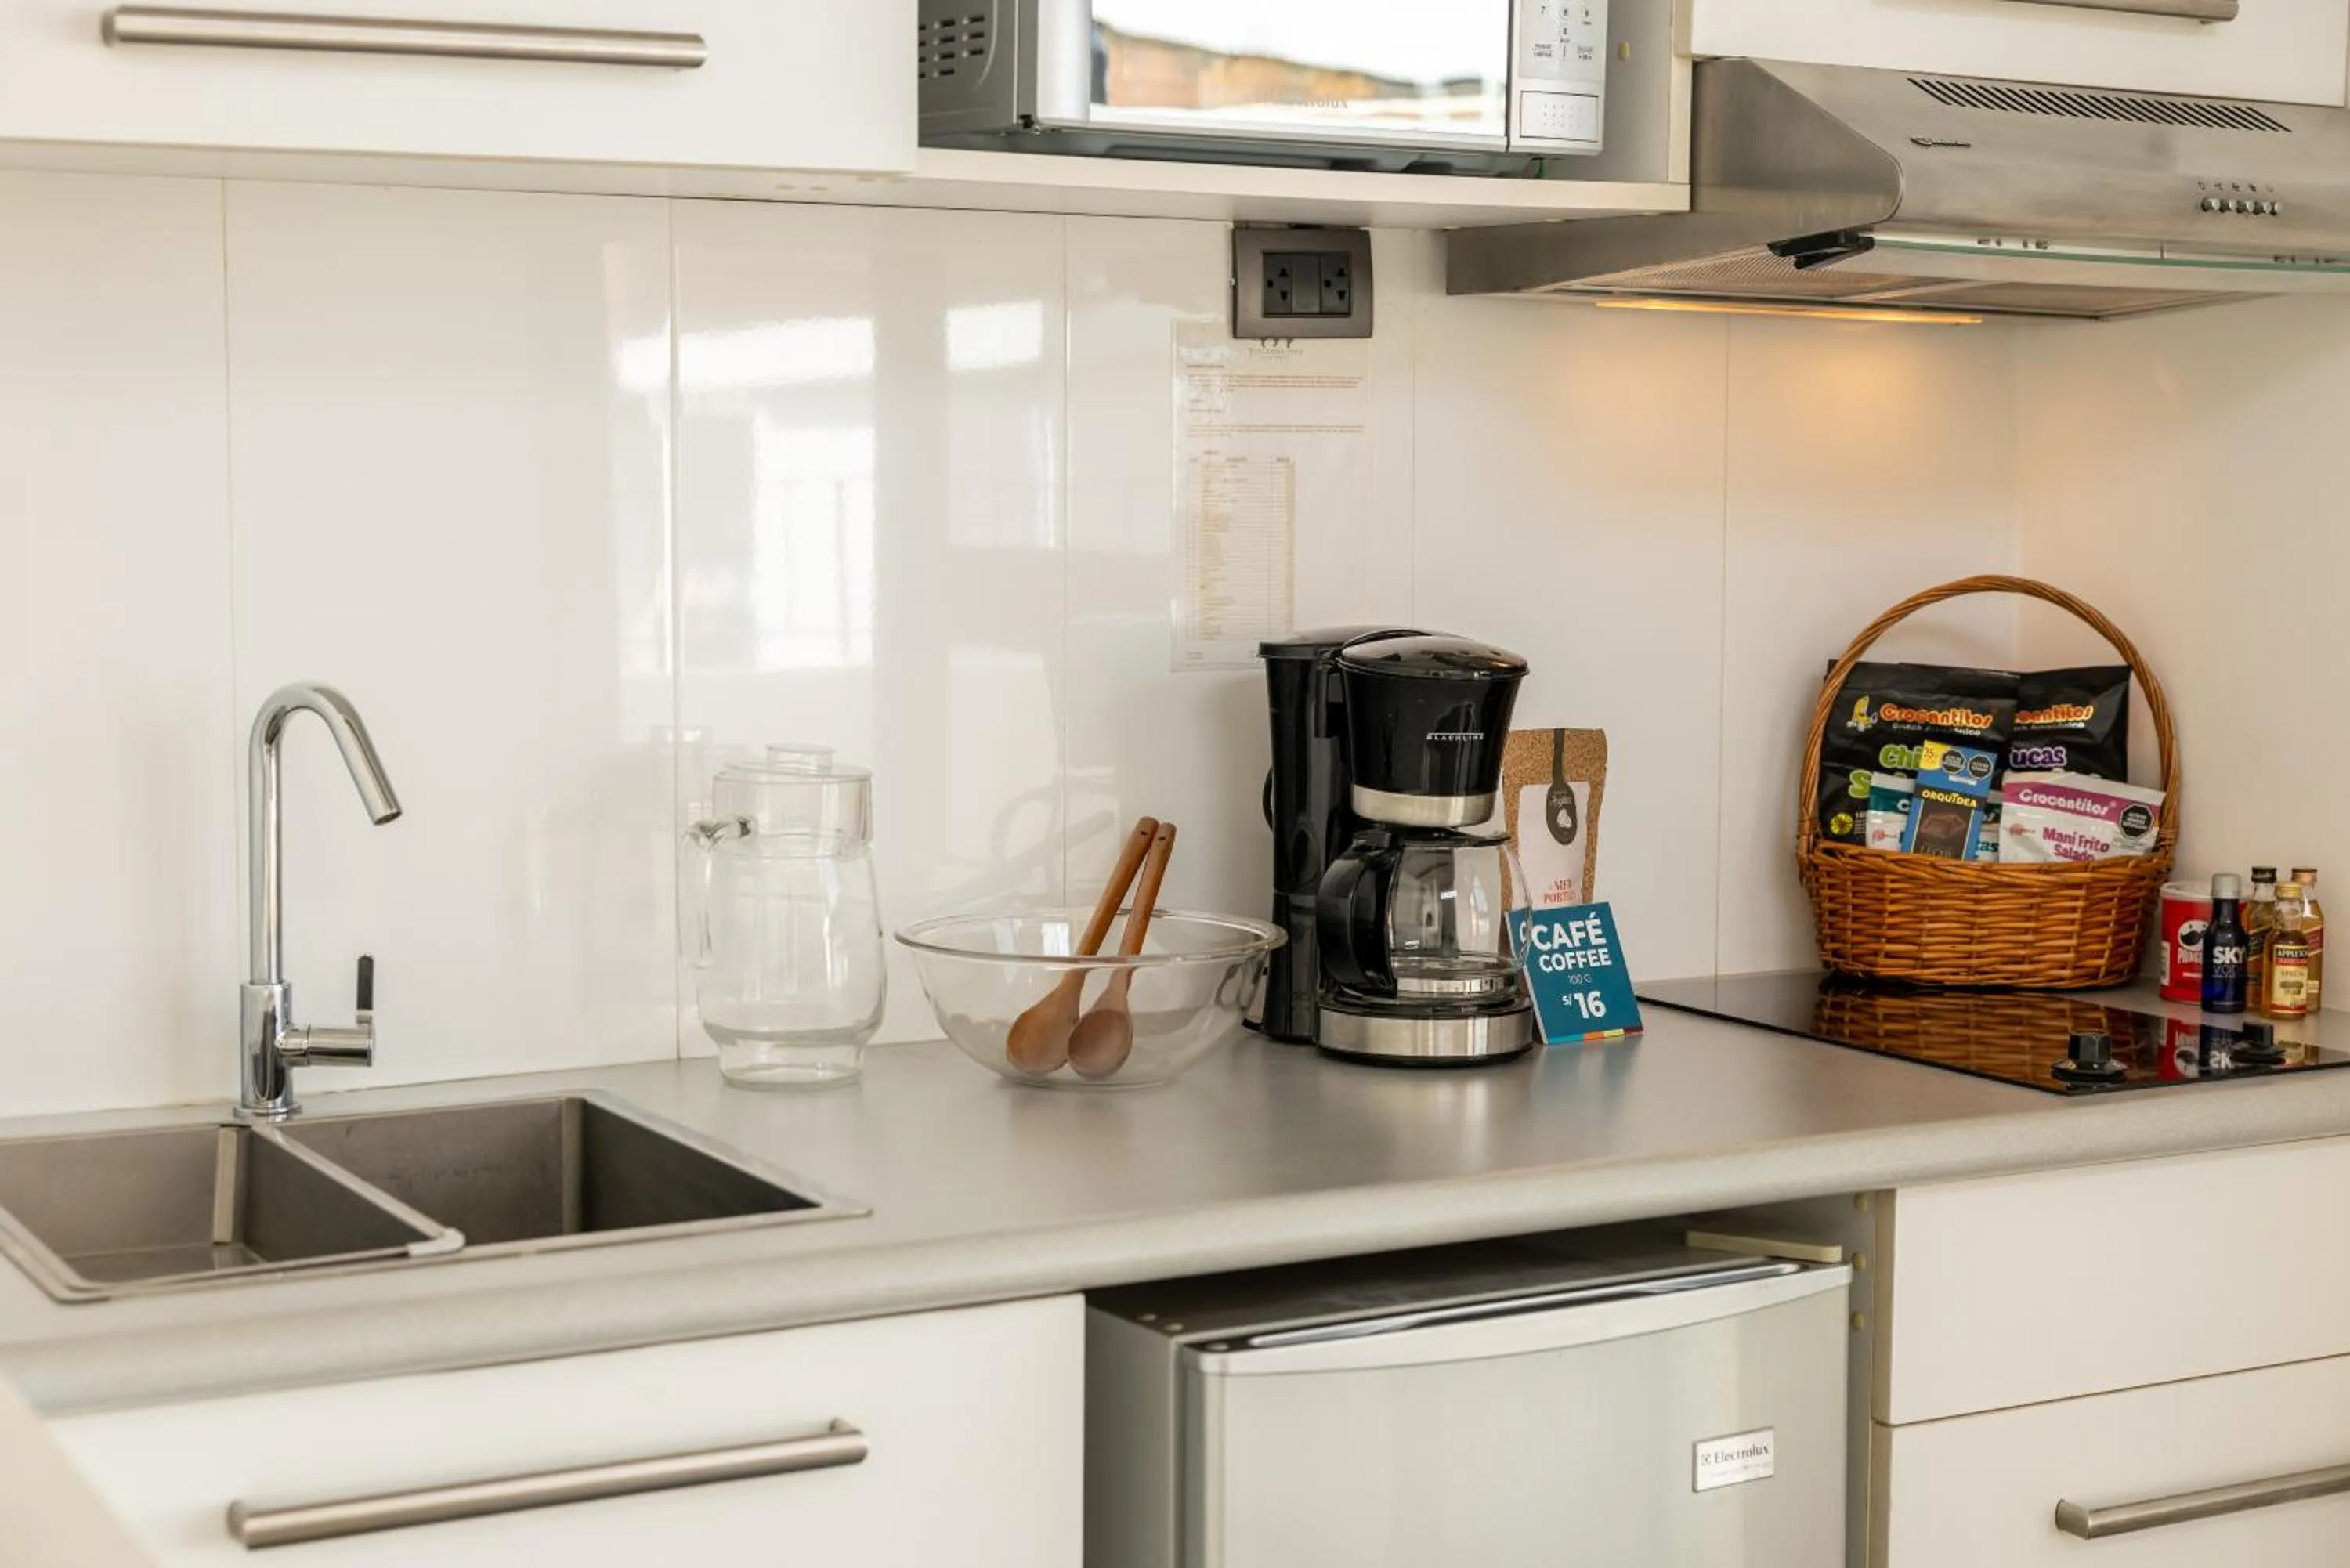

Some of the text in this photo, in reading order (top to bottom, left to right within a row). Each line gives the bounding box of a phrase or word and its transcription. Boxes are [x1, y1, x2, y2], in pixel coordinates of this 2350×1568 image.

[1880, 703, 1994, 728] Crocantitos
[1879, 744, 1923, 770] Chi
[2010, 745, 2067, 768] ucas
[2019, 789, 2109, 815] Crocantitos
[2078, 833, 2110, 854] Frito
[1531, 912, 1606, 951] CAFÉ
[1539, 948, 1612, 972] COFFEE
[2212, 945, 2246, 964] SKY
[1715, 1443, 1769, 1463] Electrolux
